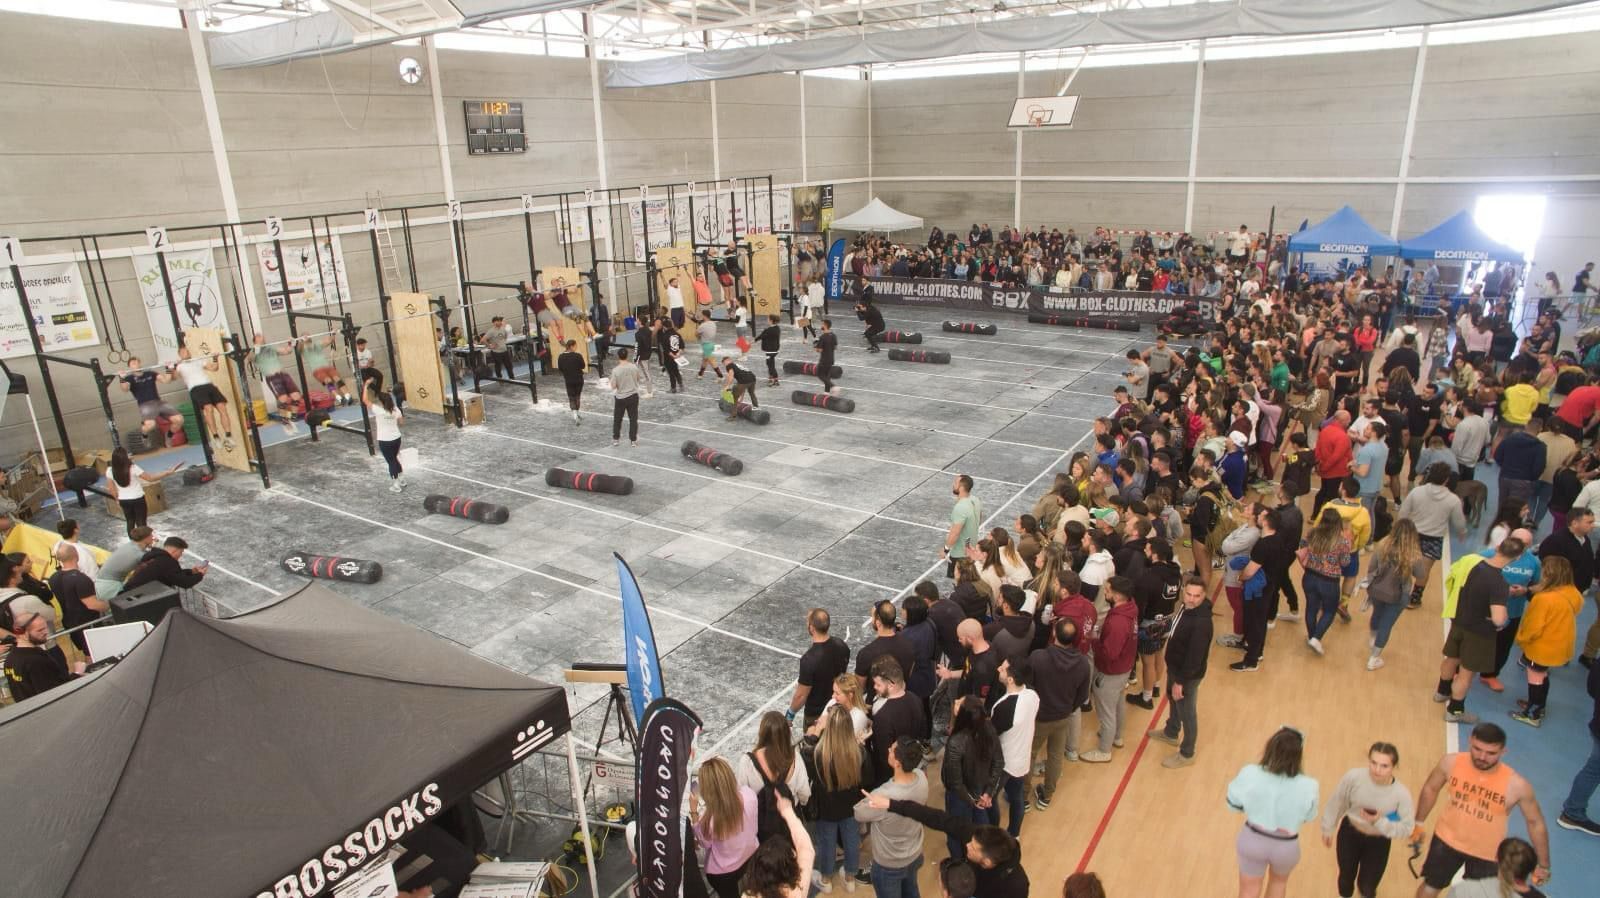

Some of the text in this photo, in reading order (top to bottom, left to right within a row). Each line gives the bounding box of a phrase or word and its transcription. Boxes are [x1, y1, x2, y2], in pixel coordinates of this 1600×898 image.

[483, 102, 508, 115] 11:27
[524, 197, 531, 209] 6
[587, 190, 593, 201] 7
[452, 204, 459, 217] 5
[368, 212, 377, 226] 4
[270, 221, 280, 237] 3
[152, 231, 164, 249] 2
[5, 241, 14, 262] 1
[1320, 243, 1369, 254] DECATHLON
[1435, 250, 1489, 260] DECATHLON
[831, 255, 840, 297] DECATHLON
[992, 291, 1031, 309] BOX
[1455, 791, 1489, 810] BE IN
[1463, 781, 1506, 807] RATHER
[1451, 799, 1494, 823] MALIBU
